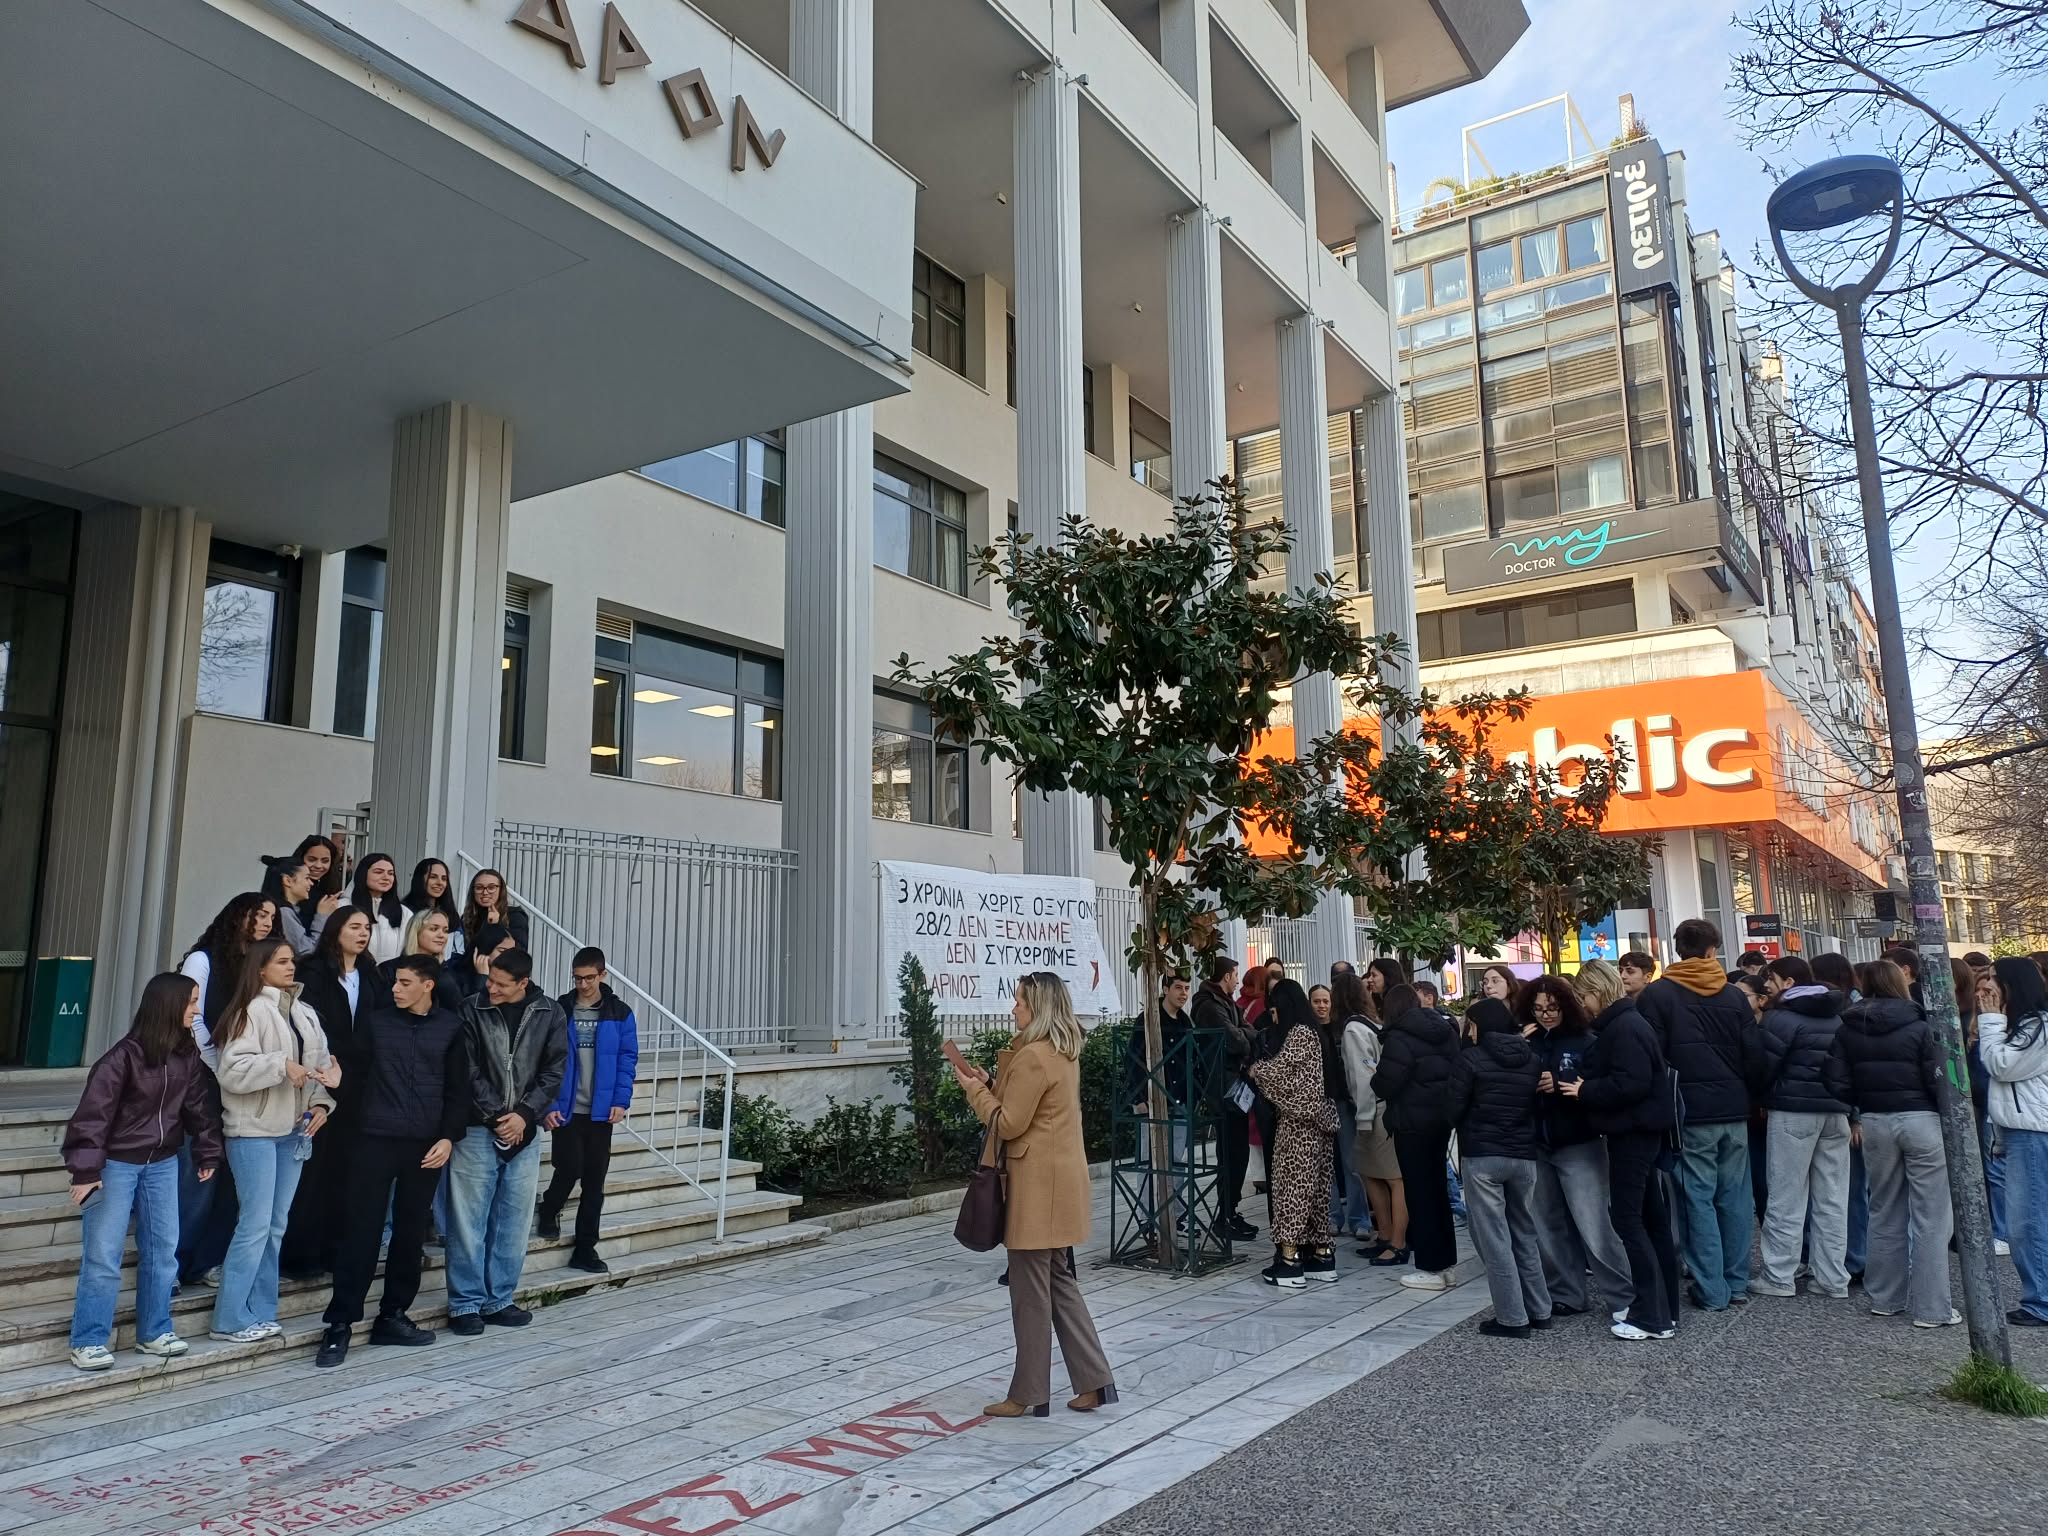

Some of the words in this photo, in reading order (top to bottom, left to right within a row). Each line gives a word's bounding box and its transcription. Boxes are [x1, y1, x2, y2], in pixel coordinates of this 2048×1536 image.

[1488, 520, 1670, 566] my
[1504, 557, 1557, 576] DOCTOR
[898, 878, 909, 904] 3
[912, 881, 965, 911] ΧΡΟΝΙΑ
[977, 893, 1025, 916] ΧΩΡΙΣ
[915, 911, 952, 937] 28/2
[958, 915, 988, 939] ΔΕΝ
[995, 918, 1072, 944] ΞΕΧΝΑΜΕ
[946, 942, 976, 965] ΔΕΝ
[985, 944, 1078, 967] ΣΥΓΧΩΡΟΥΜΕ
[923, 973, 982, 999] ΑΡΙΝΟΣ
[764, 1401, 998, 1477] ΜΑΣ
